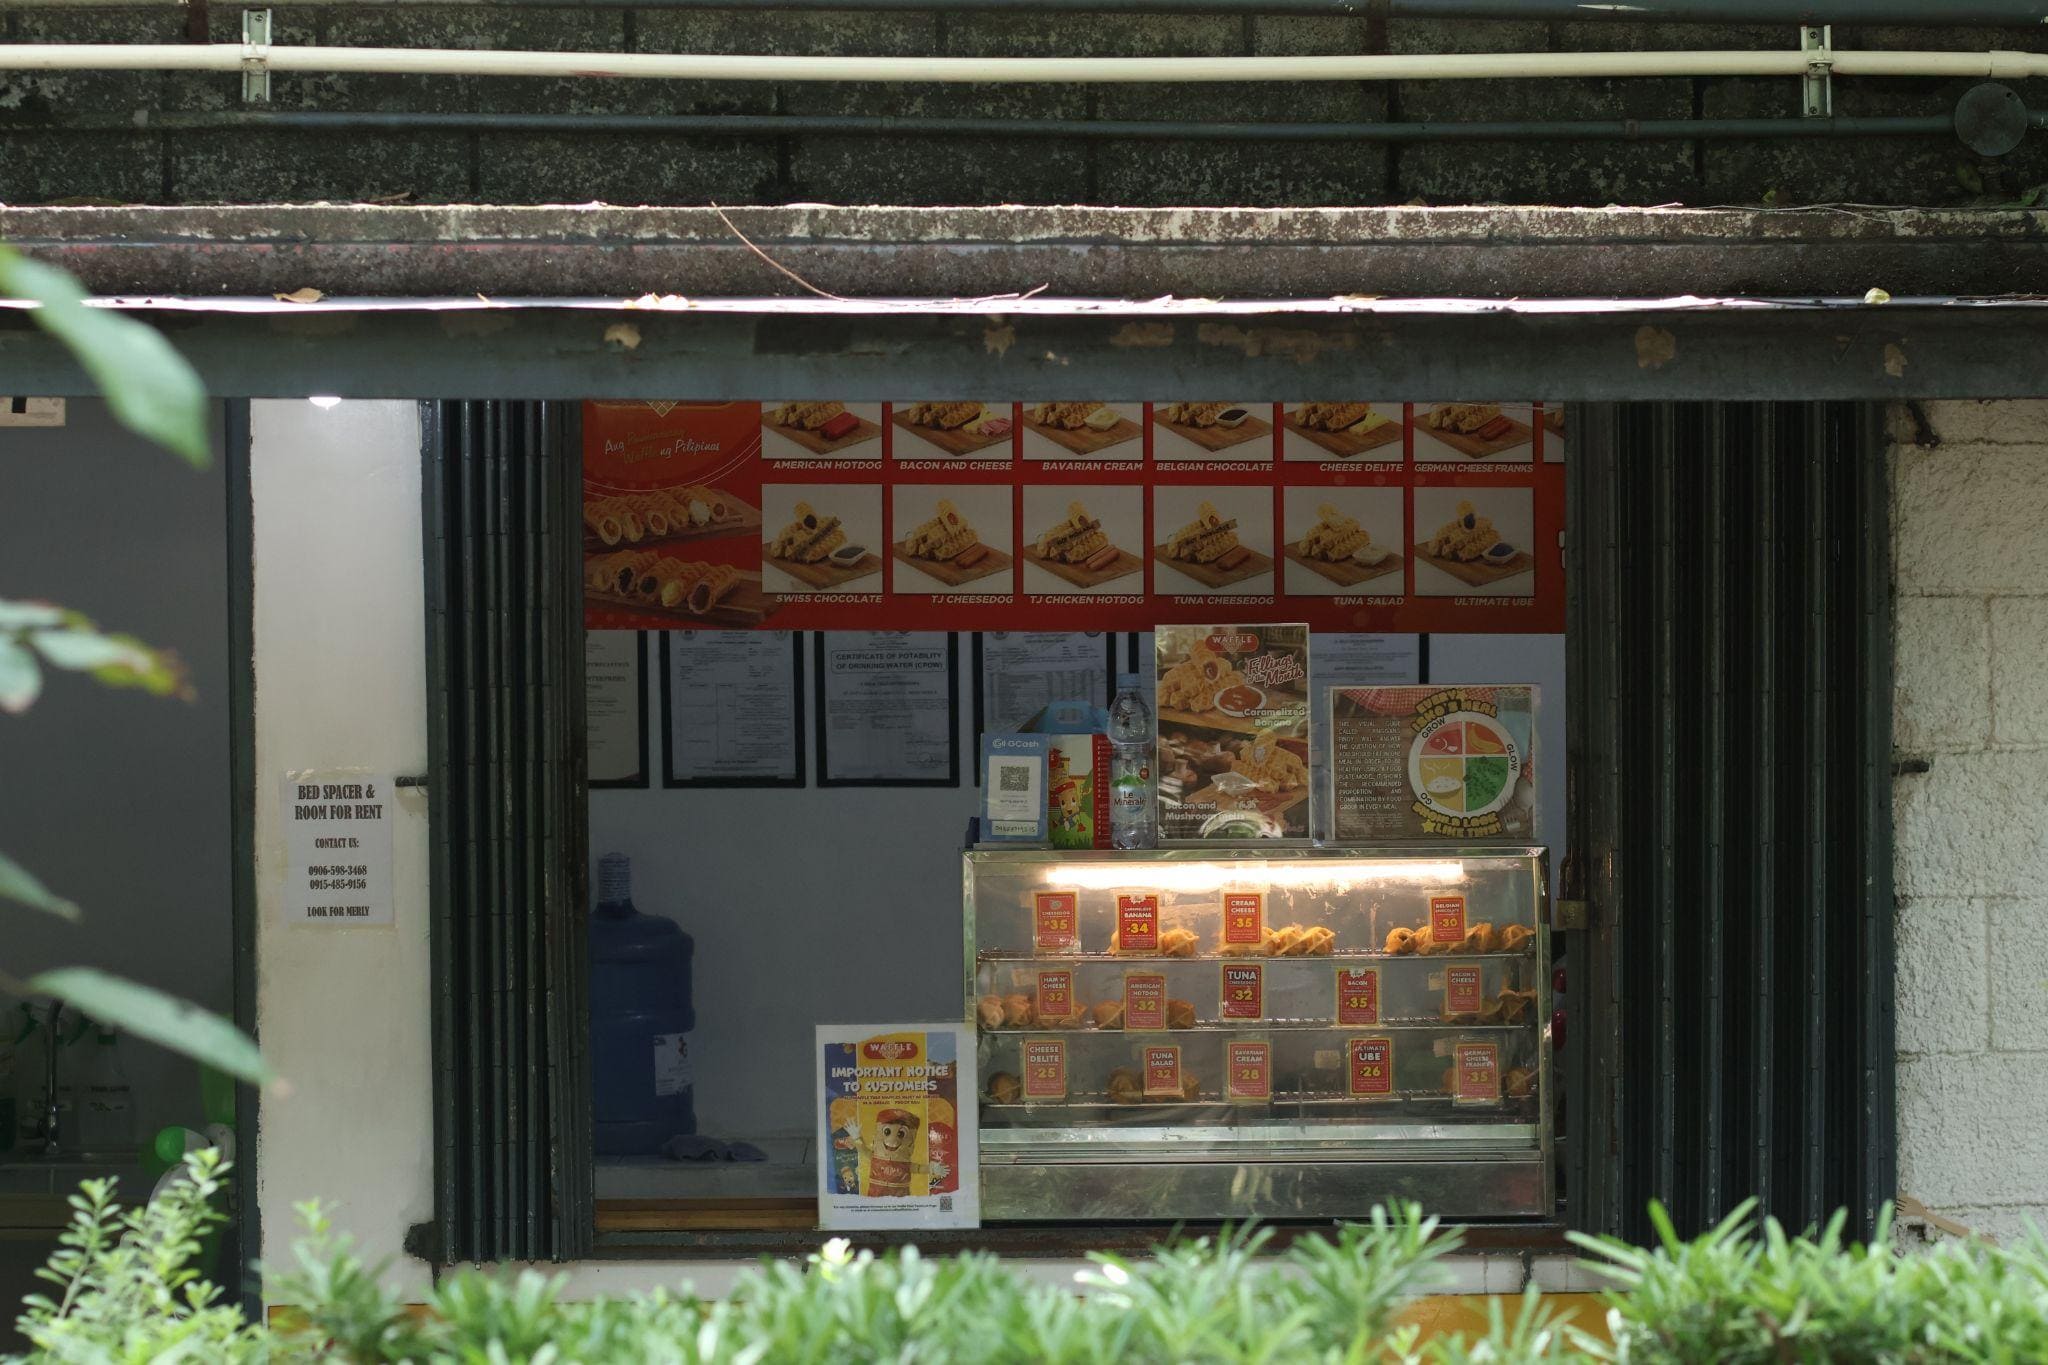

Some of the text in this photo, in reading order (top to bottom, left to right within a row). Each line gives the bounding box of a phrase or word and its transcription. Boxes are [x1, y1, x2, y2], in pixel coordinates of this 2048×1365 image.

[605, 439, 625, 455] Ang
[675, 438, 721, 455] Pilipinas
[773, 461, 883, 470] AMERICAN HOTDOG
[900, 461, 1013, 471] BACON AND CHEESE
[1042, 461, 1143, 471] BAVARIAN CREAM
[1157, 462, 1274, 472] BELGIAN CHOCOLATE
[1320, 462, 1404, 472] CHEESE DELITE
[1415, 463, 1534, 473] GERMAN CHEESE FRANKS
[776, 594, 883, 604] SWISS CHOCOLATE
[931, 595, 1014, 604] TJ CHEESEDOG
[1030, 595, 1144, 605] TJ CHICKEN HOTDOG
[1174, 596, 1275, 605] TUNA CHEESEDOG
[1332, 597, 1405, 606] TUNA SALAD
[1454, 597, 1535, 606] ULTIMATE UBE
[1211, 634, 1252, 644] WAFFLE
[898, 652, 942, 660] POTABILITY
[886, 662, 914, 670] WATER
[1264, 663, 1305, 688] Month
[1243, 707, 1306, 718] Caramelized
[1254, 717, 1292, 727] Banana
[1421, 717, 1446, 739] GROW
[1007, 739, 1040, 749] GCash
[1506, 743, 1518, 772] GLOW
[298, 783, 375, 800] BED SPACER &
[1123, 790, 1134, 799] Le
[1420, 792, 1433, 805] GO
[1198, 801, 1217, 811] and
[295, 804, 383, 821] ROOM FOR RENT
[315, 838, 360, 849] CONTACT US:
[308, 865, 368, 876] 0906-598-3468
[309, 879, 367, 890] 0915-485-9156
[307, 906, 370, 917] LOOK FOR MERLY
[1227, 970, 1257, 981] TUNA
[869, 1043, 912, 1052] WAFFLE
[1030, 1055, 1060, 1063] DELITE
[1358, 1052, 1381, 1062] UBE
[831, 1064, 949, 1078] IMPORTANT NOTICE
[843, 1079, 938, 1093] TO CUSTOMERS
